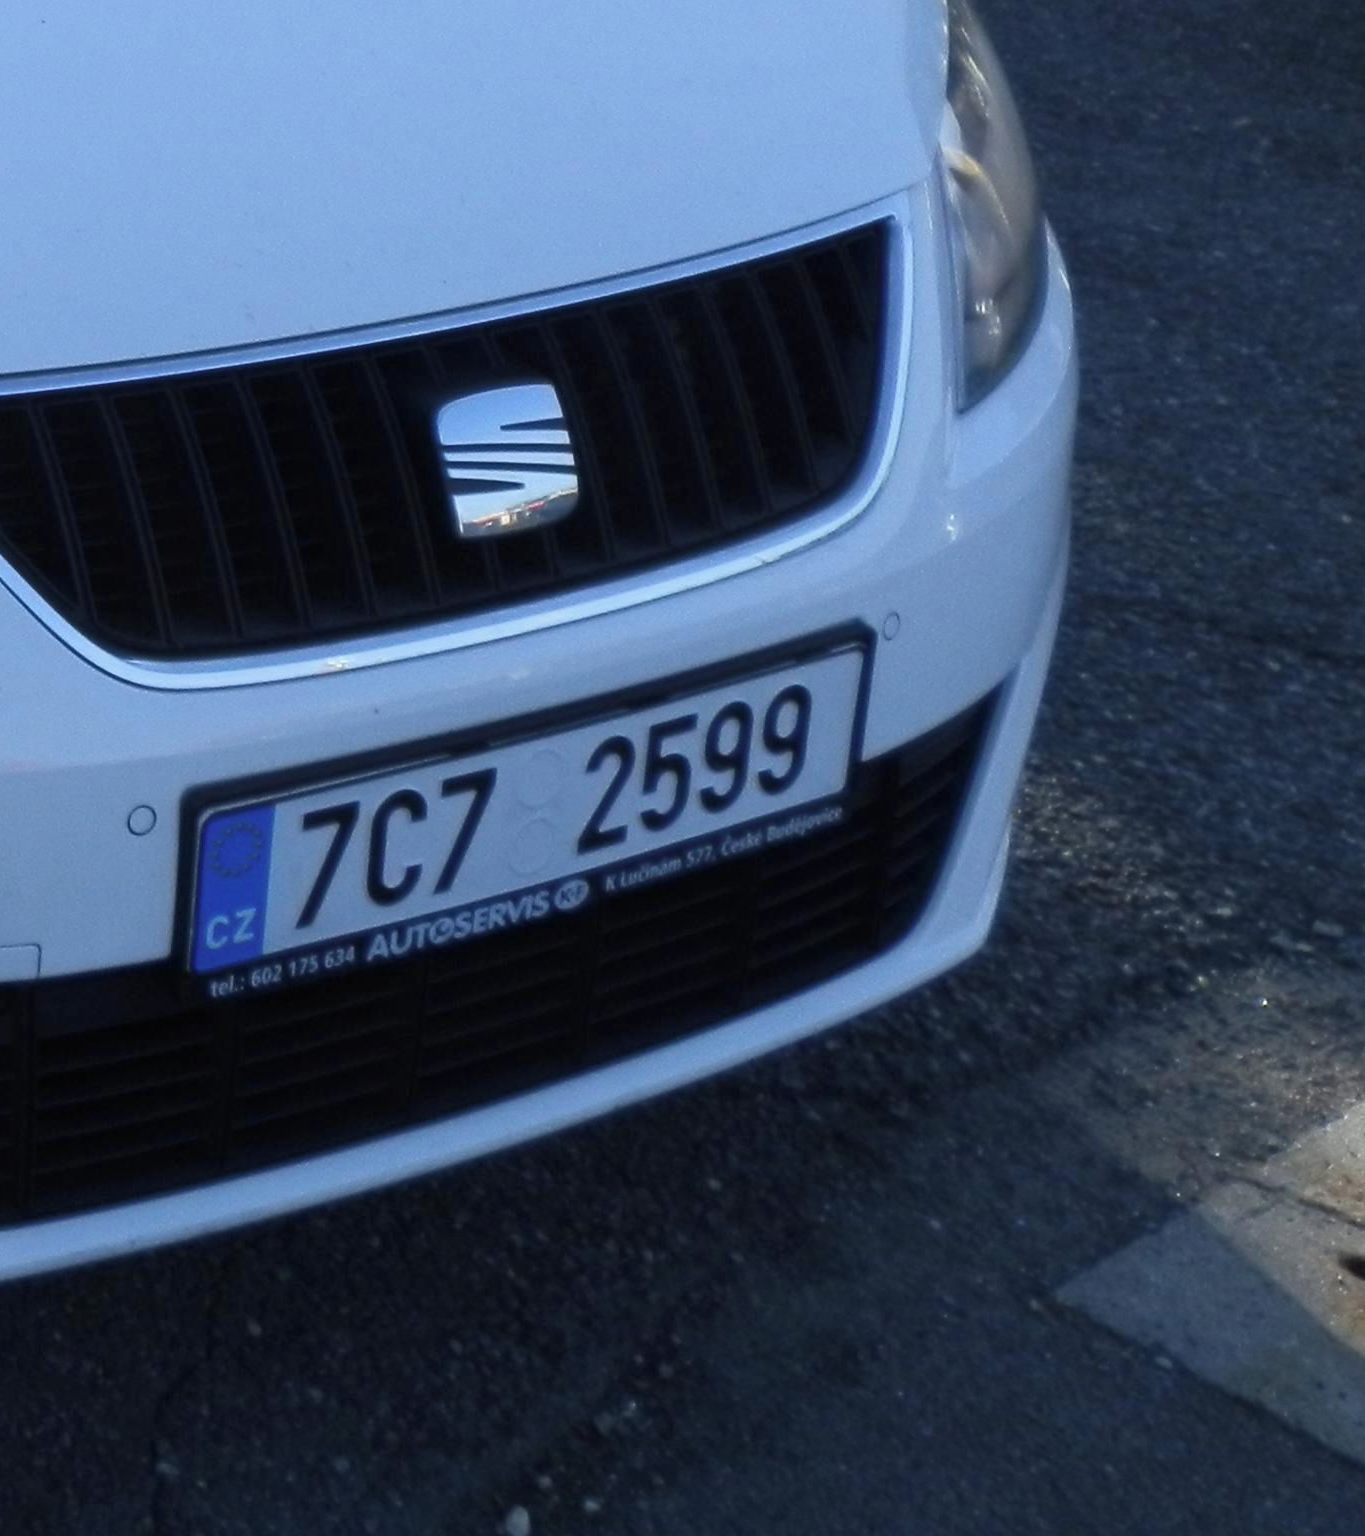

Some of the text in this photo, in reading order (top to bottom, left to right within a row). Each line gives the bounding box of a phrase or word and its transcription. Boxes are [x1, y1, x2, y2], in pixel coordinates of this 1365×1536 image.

[294, 683, 812, 929] 7C7 2599
[205, 907, 257, 951] CZ
[209, 972, 246, 998] tel.:
[250, 963, 283, 989] 602
[289, 953, 320, 979] 175
[323, 944, 357, 970] 634
[367, 890, 550, 963] AUTOSERVIS
